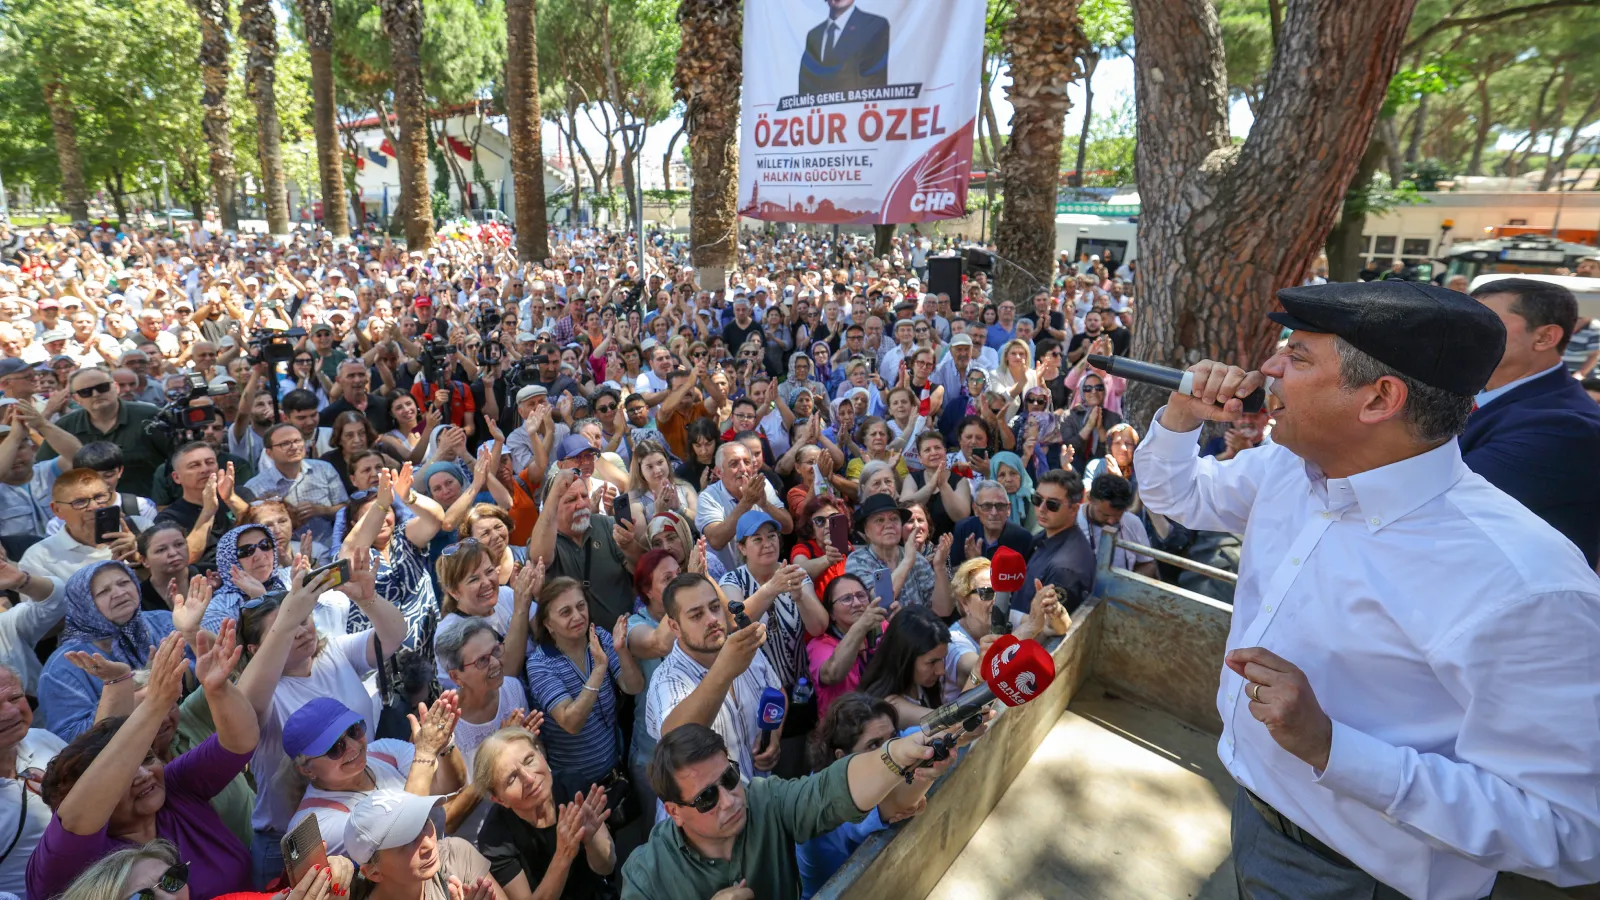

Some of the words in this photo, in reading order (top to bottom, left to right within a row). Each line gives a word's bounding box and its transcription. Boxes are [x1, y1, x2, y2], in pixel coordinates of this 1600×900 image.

[781, 95, 815, 110] SEÇİLMİŞ
[816, 91, 847, 104] GENEL
[848, 86, 916, 101] BAŞKANIMIZ
[754, 108, 847, 148] ÖZGÜR
[858, 103, 946, 142] ÖZEL
[756, 155, 800, 169] MİLLETİN
[802, 154, 873, 169] İRADESİYLE,
[763, 170, 802, 183] HALKIN
[805, 168, 862, 182] GÜCÜYLE
[910, 191, 956, 212] CHP
[998, 572, 1025, 581] DHA
[999, 681, 1026, 704] anka
